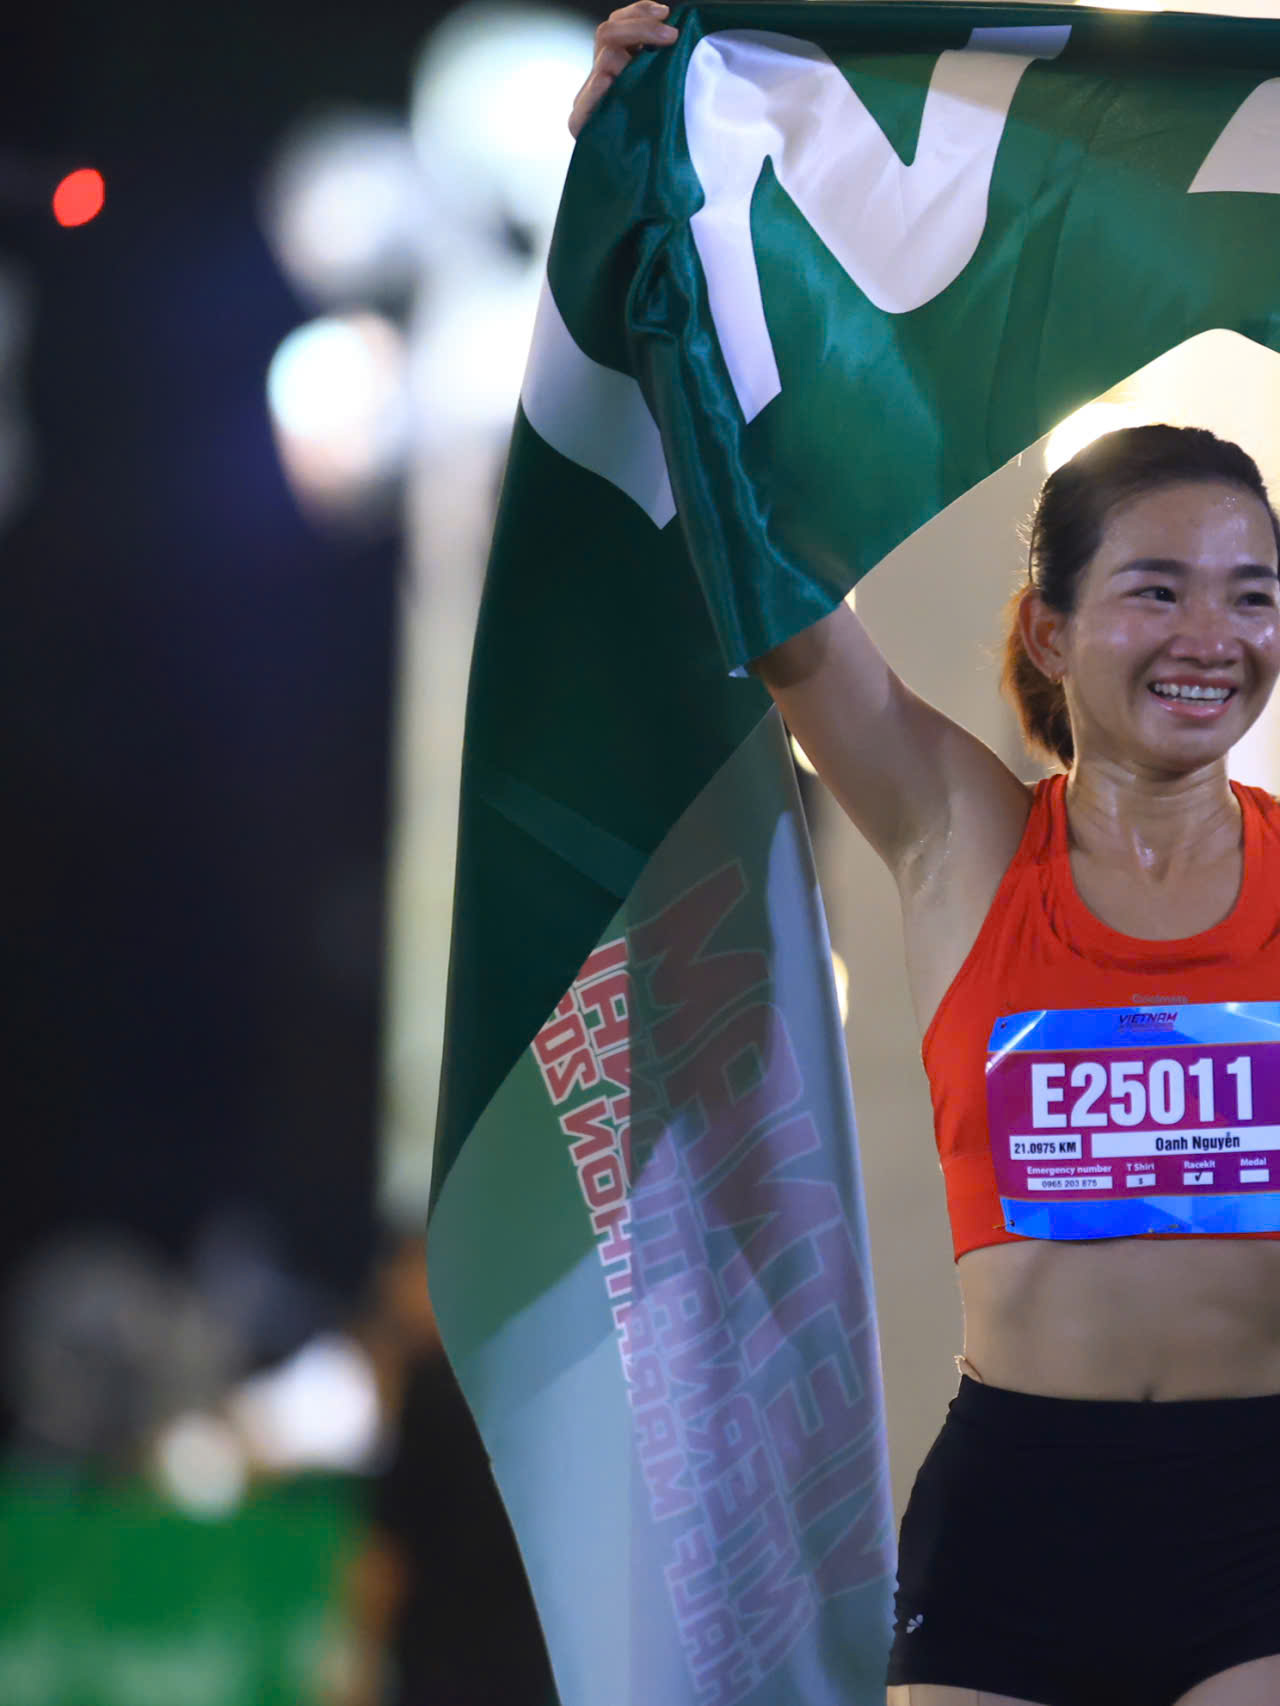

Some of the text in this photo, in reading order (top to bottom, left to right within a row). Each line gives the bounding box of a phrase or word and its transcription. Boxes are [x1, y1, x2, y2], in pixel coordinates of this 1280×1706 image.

[1119, 1011, 1178, 1024] VIETNAM
[1030, 1056, 1254, 1129] E25011
[1013, 1141, 1077, 1155] 21.0975 KM
[1155, 1136, 1188, 1151] Oanh
[1126, 1162, 1155, 1171] T Shirt
[1183, 1159, 1216, 1169] Racekit
[1240, 1156, 1267, 1167] Medal
[1026, 1164, 1112, 1176] Emergency number
